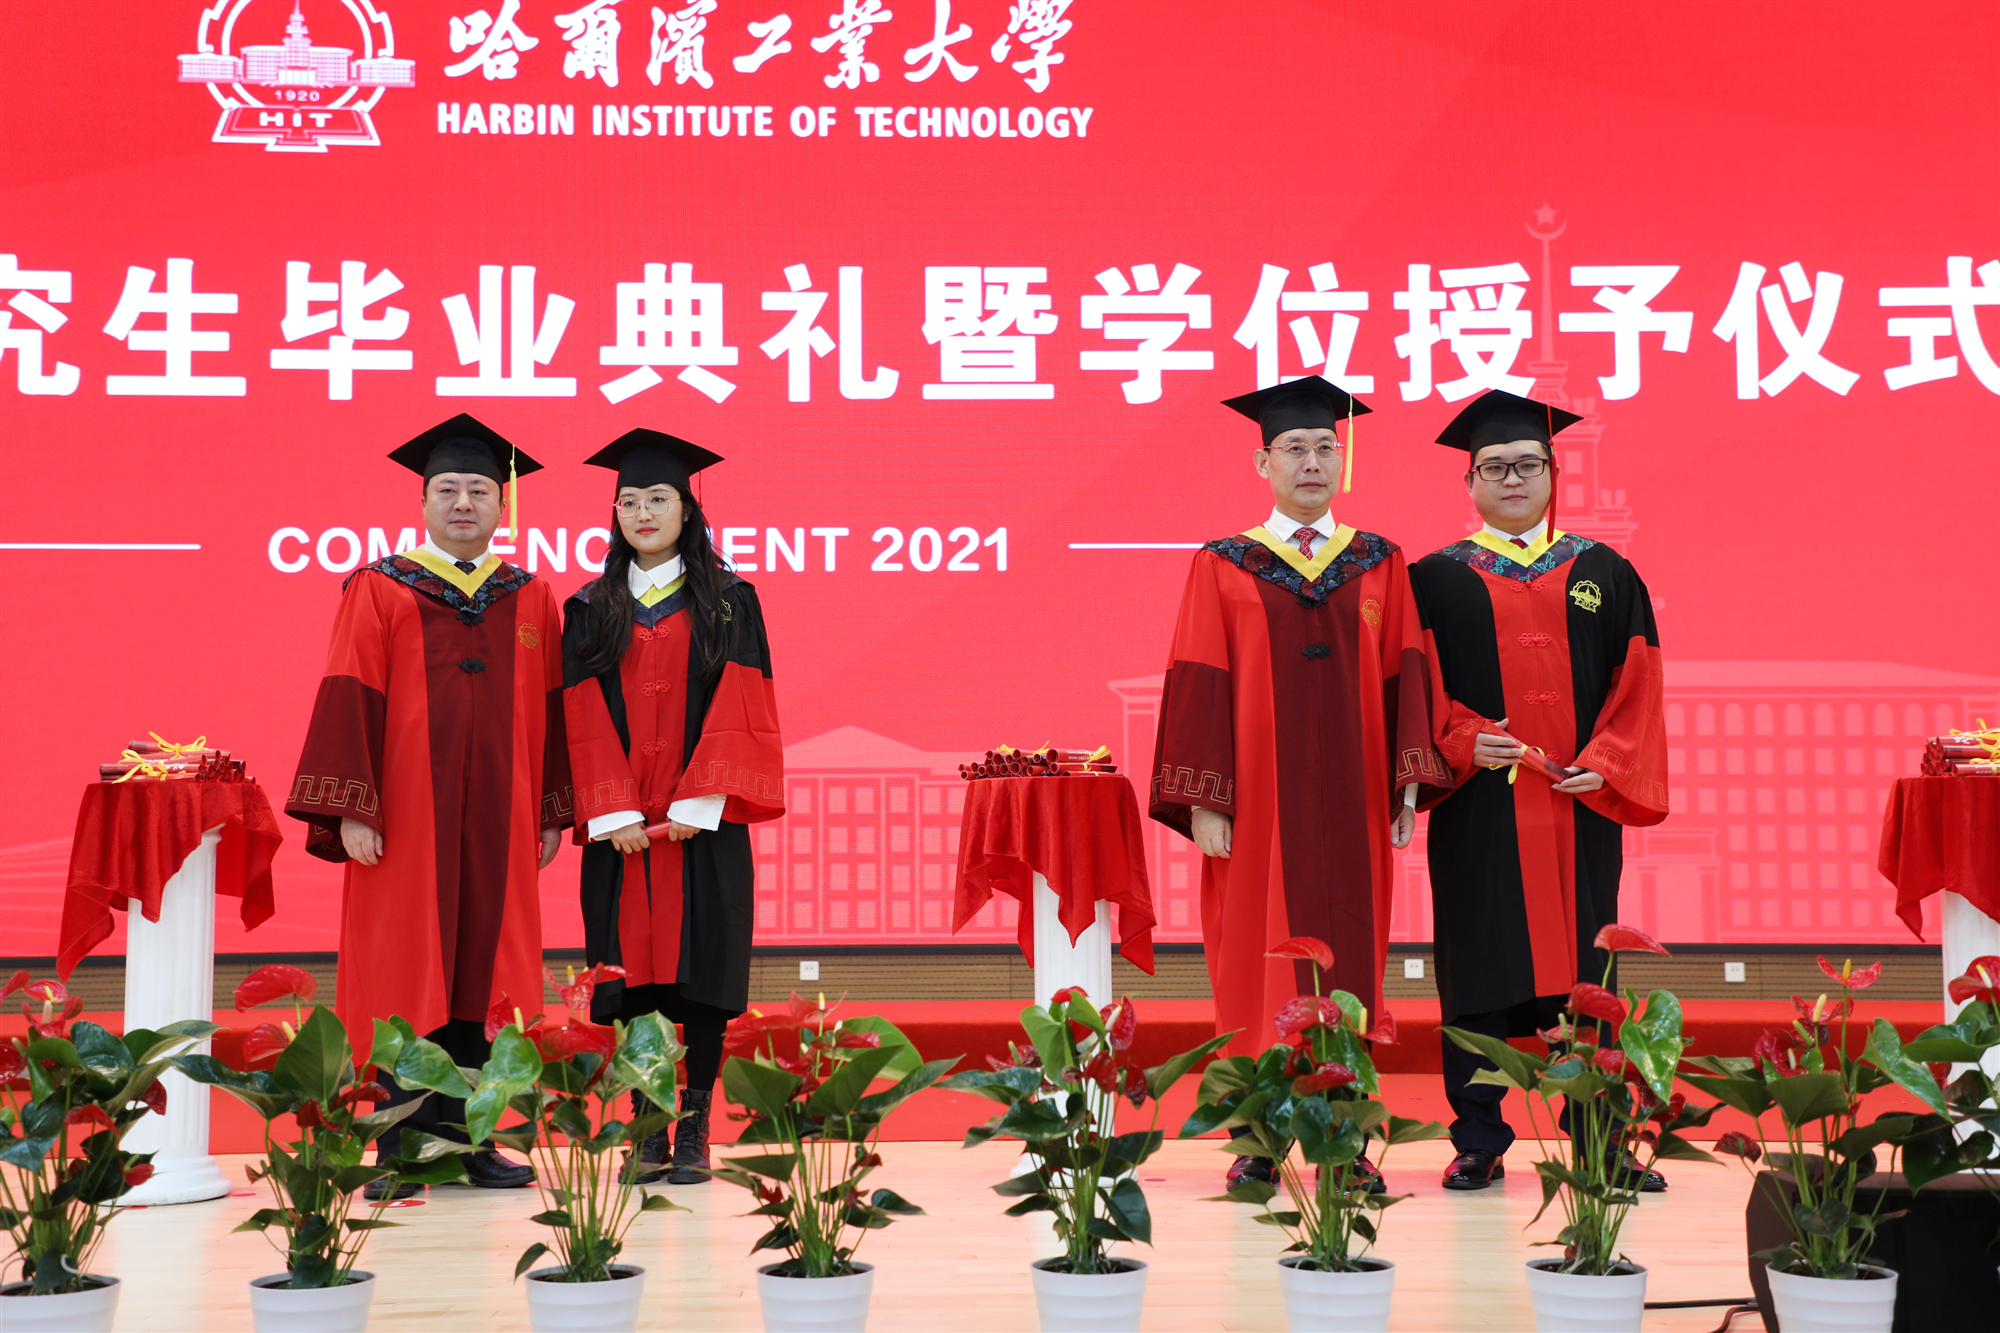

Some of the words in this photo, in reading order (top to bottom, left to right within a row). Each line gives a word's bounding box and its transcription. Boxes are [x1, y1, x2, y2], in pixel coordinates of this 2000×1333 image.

[274, 89, 321, 103] 1920
[259, 111, 333, 128] HIT
[437, 102, 574, 136] HARBIN
[592, 104, 774, 138] INSTITUTE
[789, 105, 837, 138] OF
[854, 106, 1094, 139] TECHNOLOGY
[870, 526, 1009, 573] 2021
